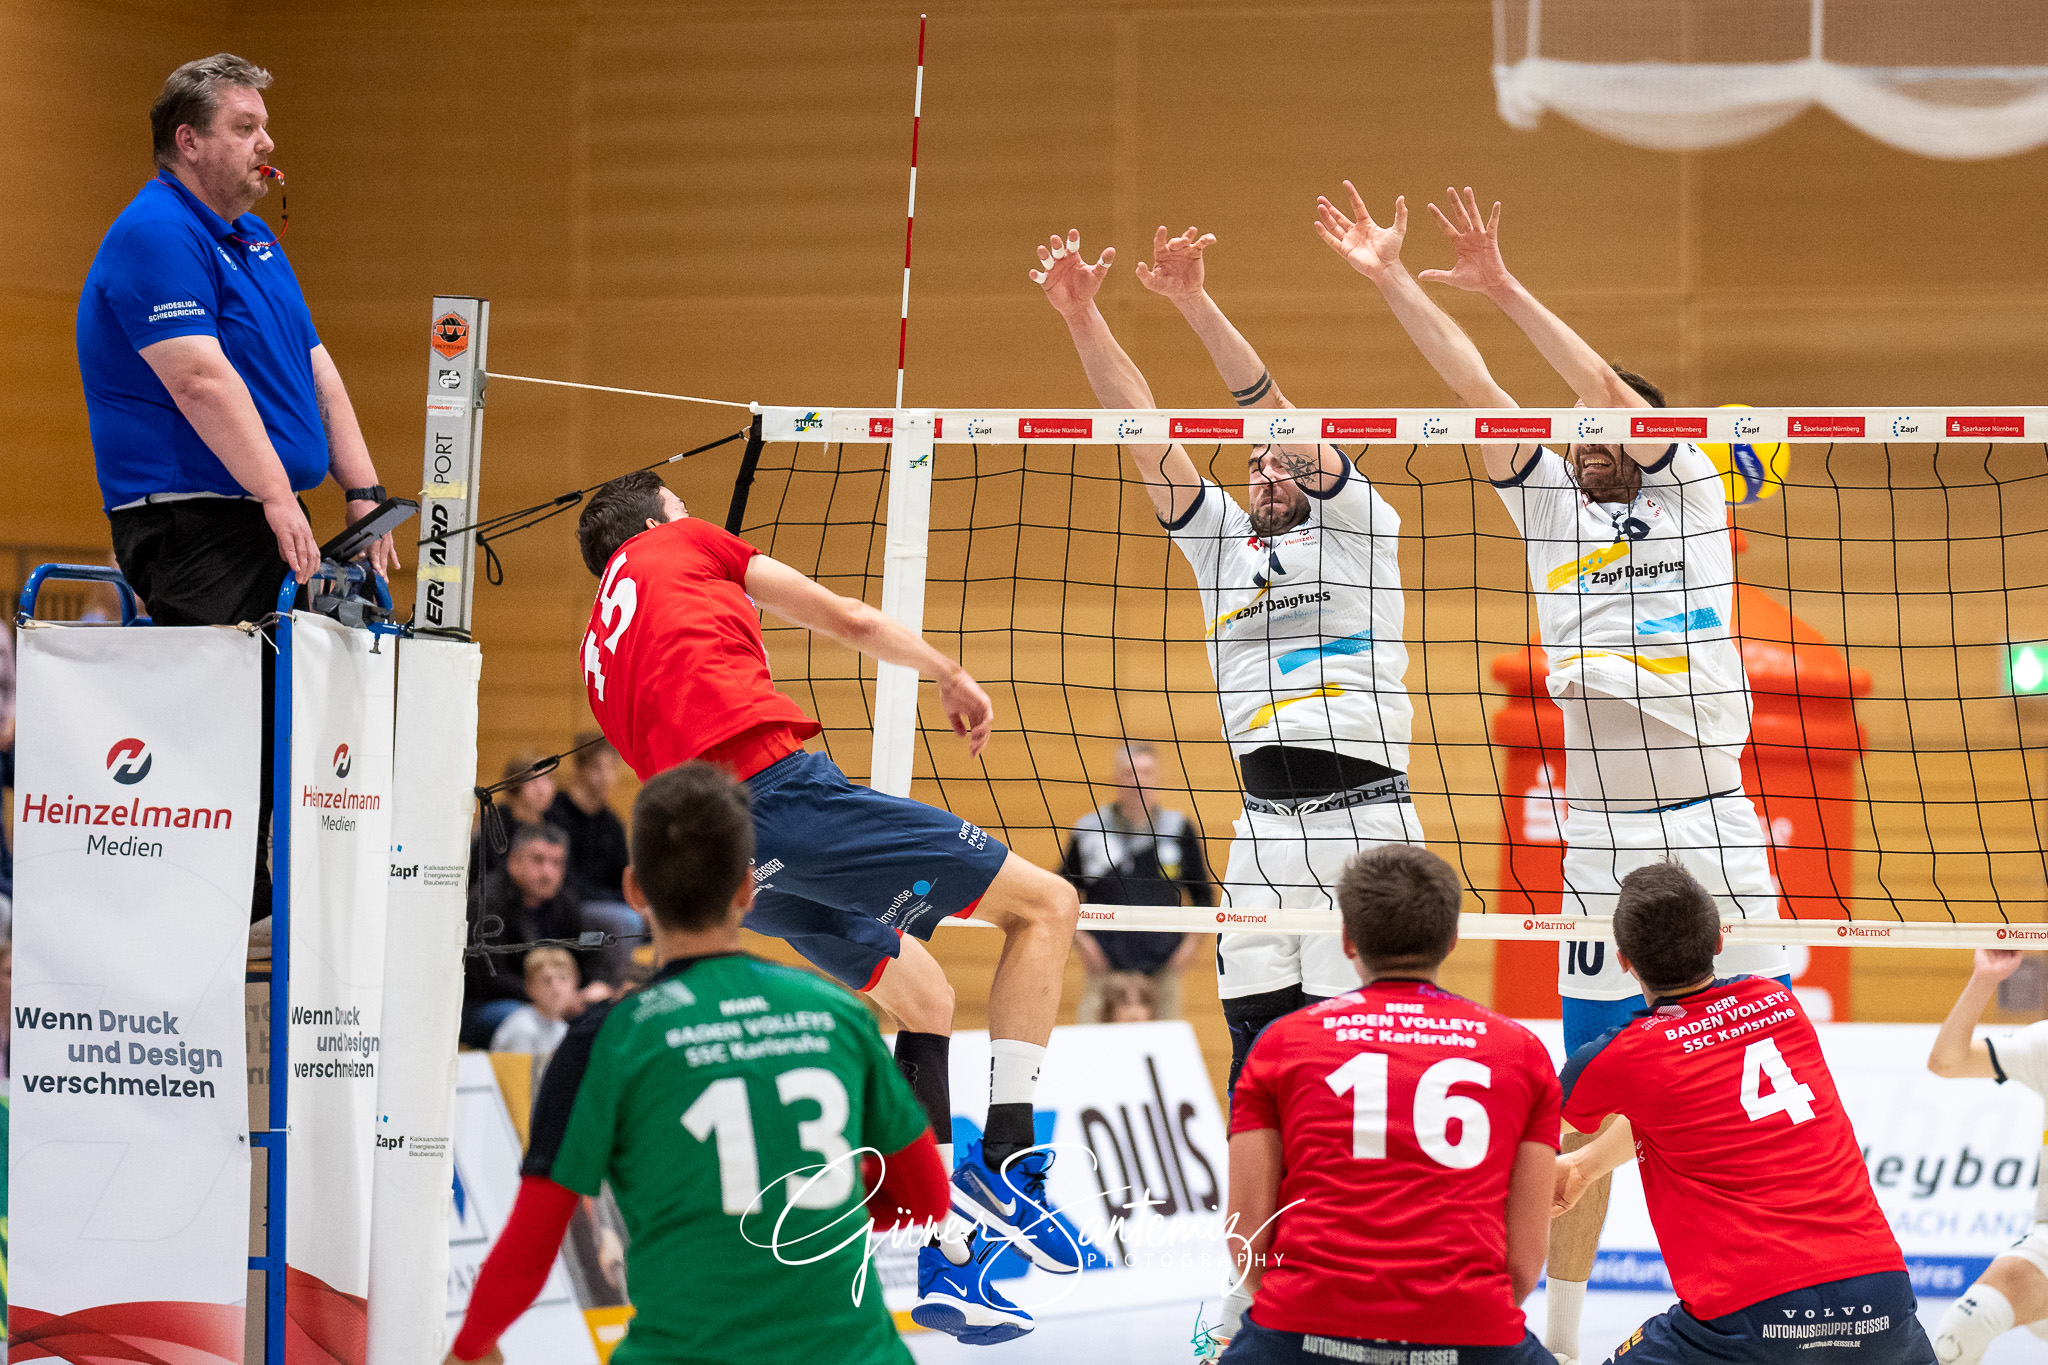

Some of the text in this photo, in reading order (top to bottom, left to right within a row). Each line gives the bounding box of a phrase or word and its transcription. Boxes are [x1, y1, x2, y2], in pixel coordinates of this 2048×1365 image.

[148, 309, 205, 322] SCHIEDSRICHTER
[153, 301, 197, 312] BUNDESLIGA
[794, 419, 823, 428] HUCK
[1675, 426, 1702, 434] Nürnberg
[1741, 426, 1760, 434] Zapf
[1803, 425, 1860, 433] Sparkasse Nürnberg
[1900, 425, 1919, 433] Zapf
[1962, 425, 2019, 433] Sparkasse Nürnberg
[433, 432, 453, 484] PORT
[426, 503, 449, 627] ERARD
[1592, 567, 1622, 585] Zapf
[1266, 591, 1331, 612] Daigfuss
[302, 785, 381, 810] Heinzelmann
[22, 793, 233, 830] Heinzelmann
[321, 815, 356, 831] Medien
[86, 834, 163, 857] Medien
[390, 864, 419, 880] Zapf
[752, 858, 785, 883] GEISSER
[875, 889, 913, 925] Impulse
[1077, 910, 1115, 920] Marmot
[1227, 913, 1267, 923] Marmot
[1535, 920, 1576, 930] Marmot
[1849, 927, 1891, 937] Marmot
[1566, 940, 1604, 976] 10
[1705, 995, 1739, 1014] DERR
[15, 1007, 180, 1034] Wenn Druck
[292, 1006, 333, 1025] Wenn
[335, 1006, 360, 1026] Druck
[1323, 1014, 1487, 1035] BADEN VOLLEYS
[1664, 1014, 1724, 1041] BADEN
[1726, 990, 1790, 1022] VOLLEYS
[1336, 1028, 1477, 1048] SSC Karlsruhe
[1682, 1034, 1715, 1054] SSC
[1716, 1008, 1795, 1042] Karlsruhe
[317, 1031, 380, 1058] und Design
[68, 1040, 121, 1064] und
[128, 1041, 222, 1074] Design
[294, 1059, 374, 1078] verschmelzen
[22, 1072, 215, 1098] verschmelzen
[1739, 1037, 1816, 1125] 4
[1324, 1051, 1491, 1170] 16
[376, 1134, 405, 1150] Zapf
[680, 1067, 855, 1215] 13
[1080, 1053, 1220, 1269] puls
[1782, 1304, 1873, 1319] VOLVO
[1762, 1315, 1890, 1339] AUTOHAUSGRUPPE GEISSER
[1410, 1349, 1459, 1365] GEISSER
